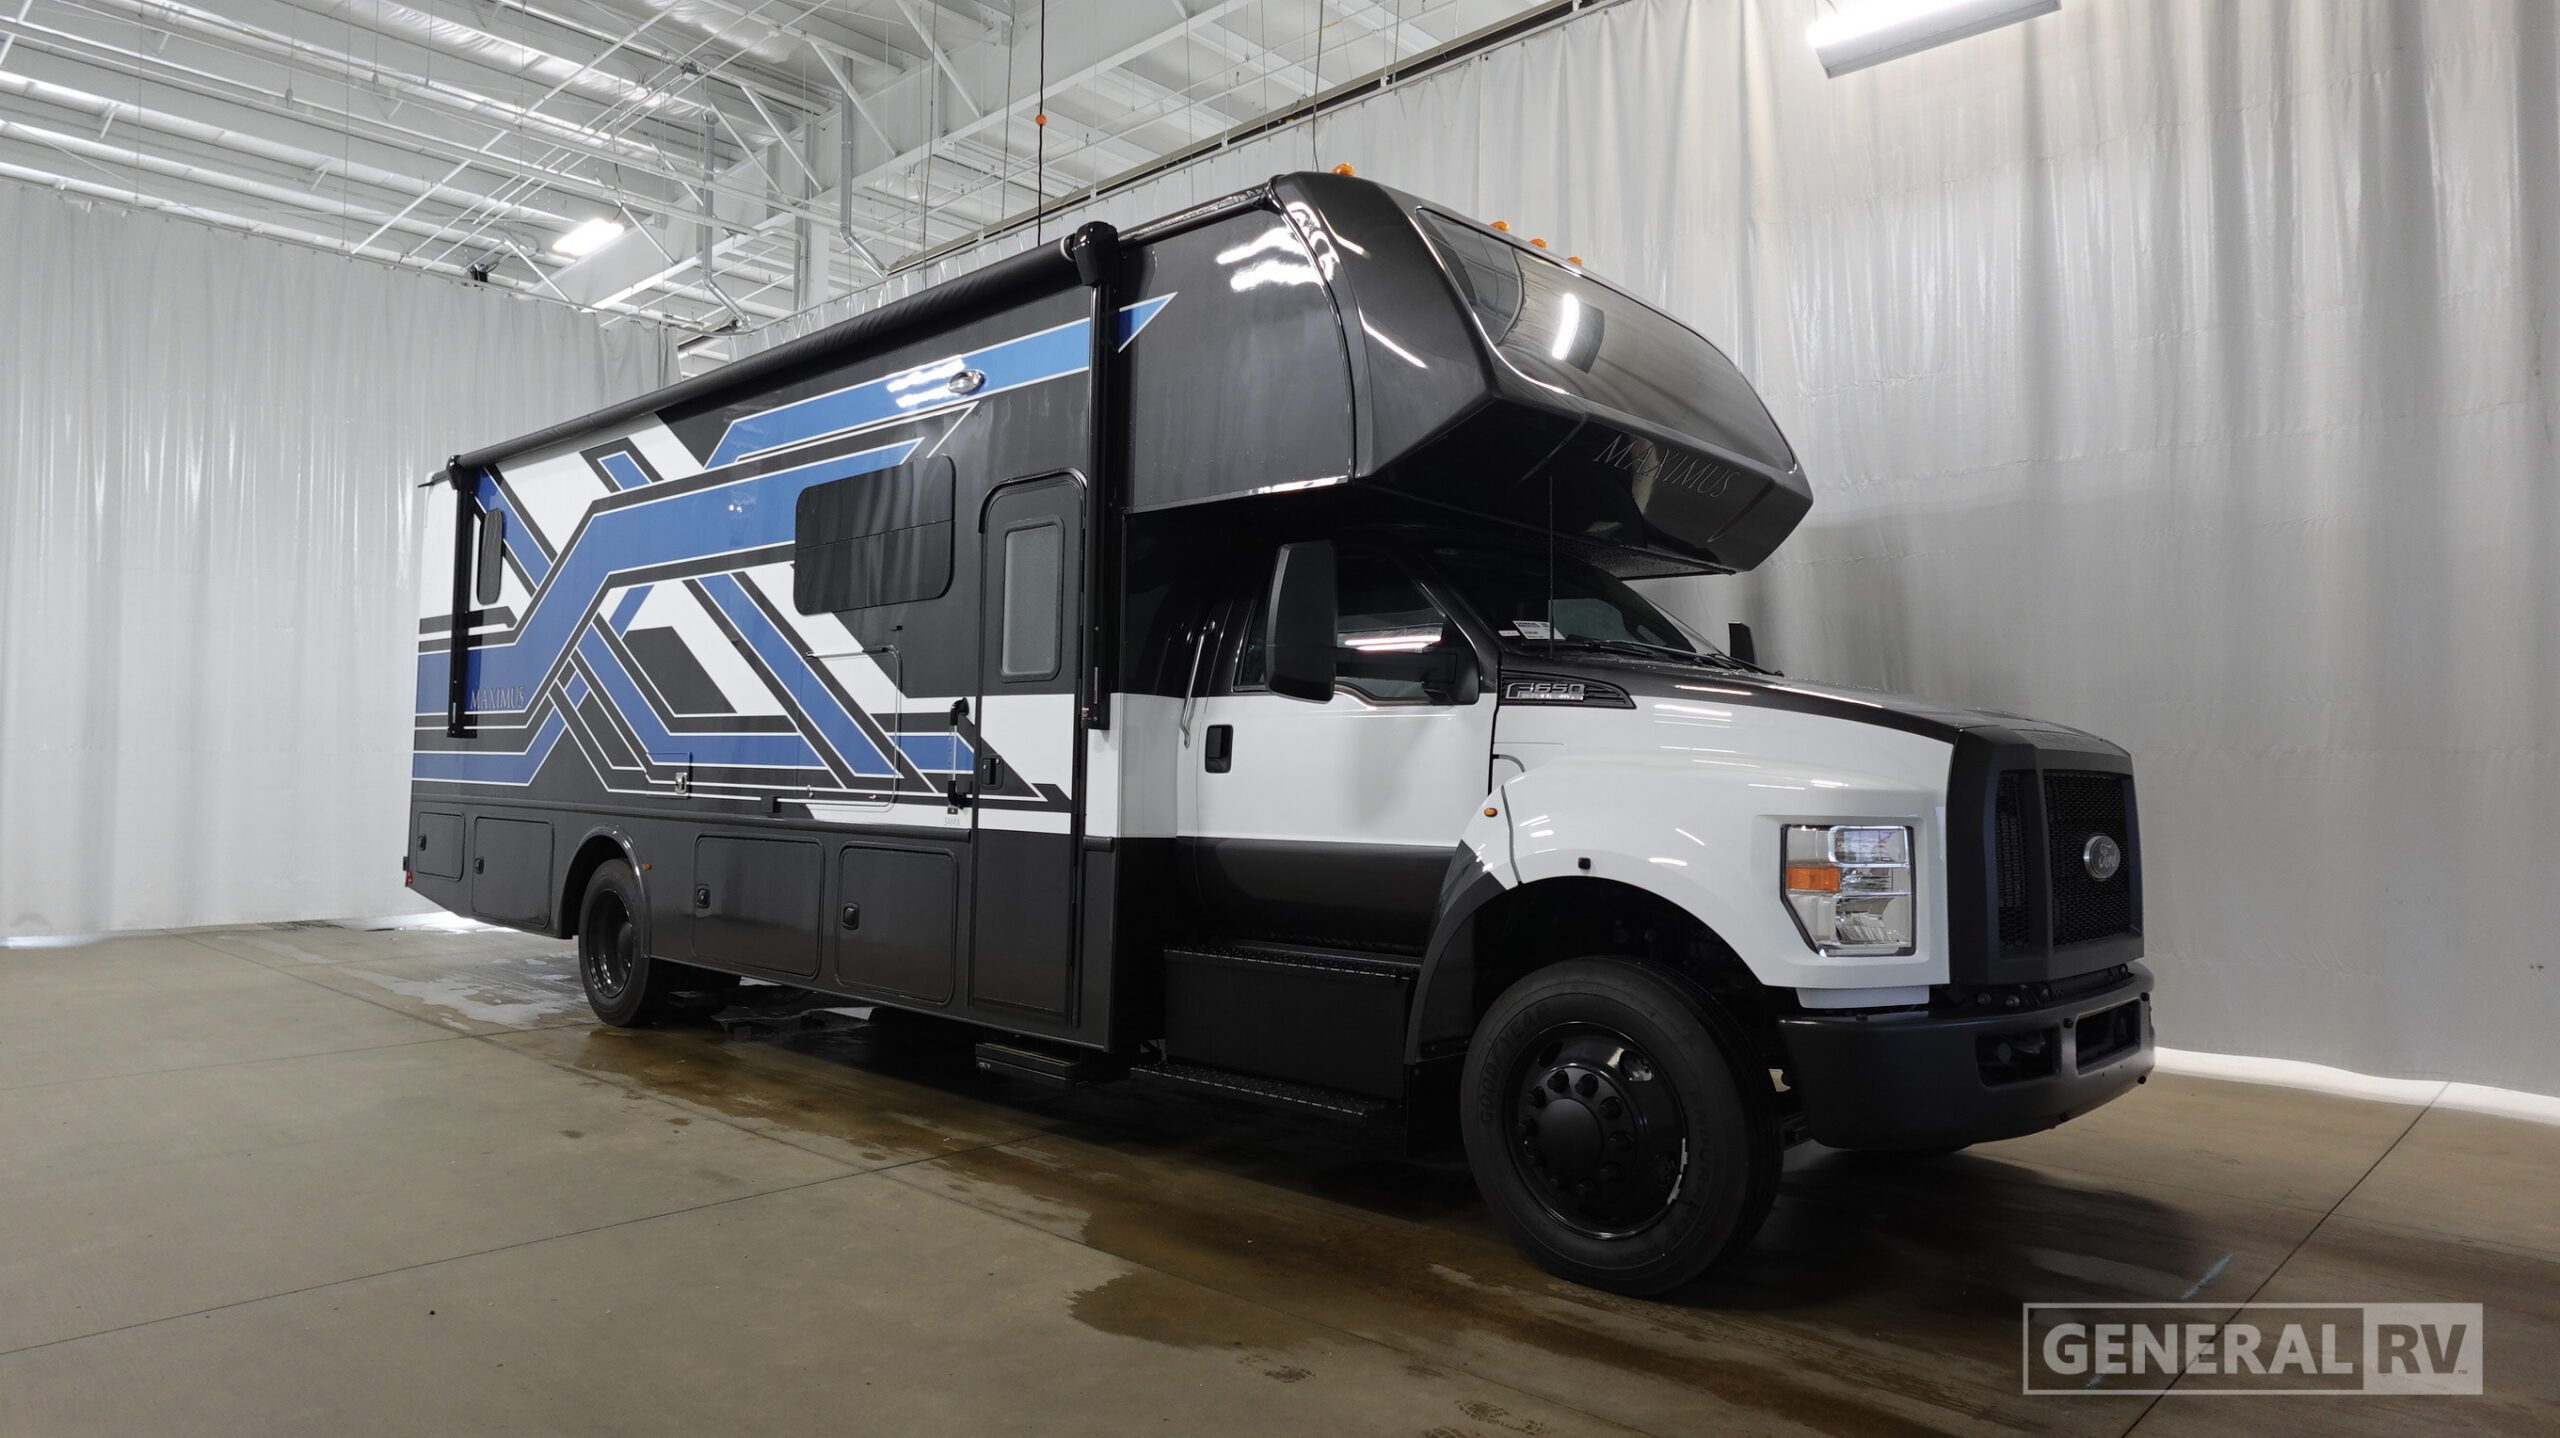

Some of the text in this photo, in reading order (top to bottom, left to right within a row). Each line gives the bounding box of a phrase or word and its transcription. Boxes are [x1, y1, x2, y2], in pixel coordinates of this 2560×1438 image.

[1593, 435, 1740, 497] MAXIMUS
[470, 687, 525, 709] MAXIMUS
[2097, 843, 2118, 868] Ford
